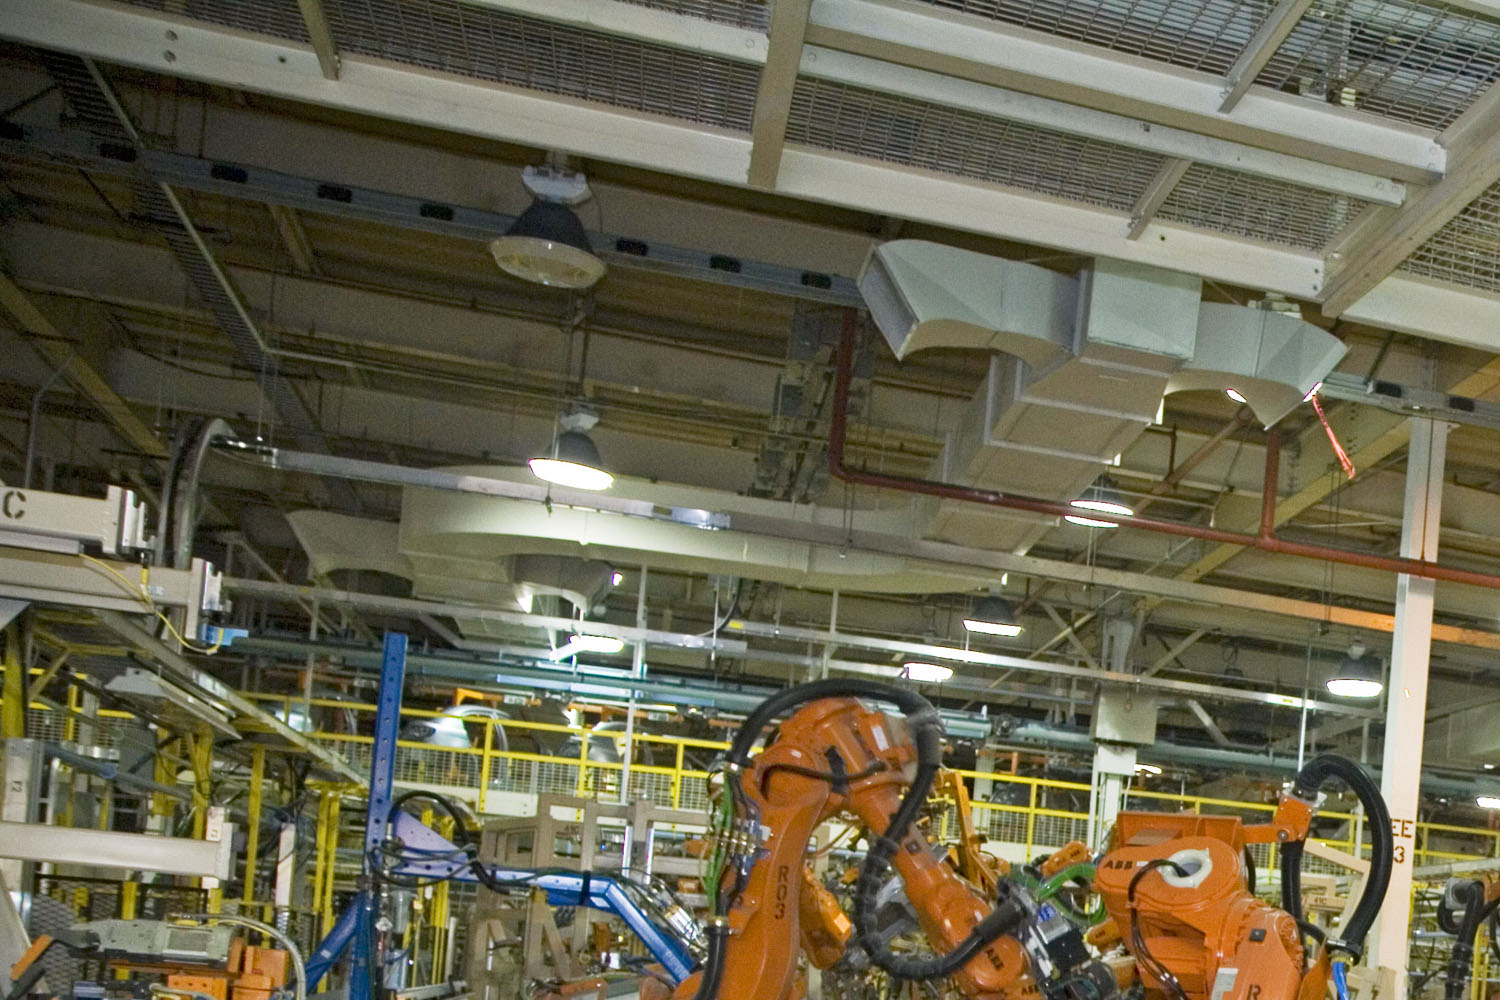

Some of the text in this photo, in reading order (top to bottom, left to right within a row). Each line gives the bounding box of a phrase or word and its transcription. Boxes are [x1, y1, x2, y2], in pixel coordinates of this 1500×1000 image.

[1394, 846, 1405, 864] 3
[1104, 861, 1134, 870] ABB
[774, 865, 789, 919] R03
